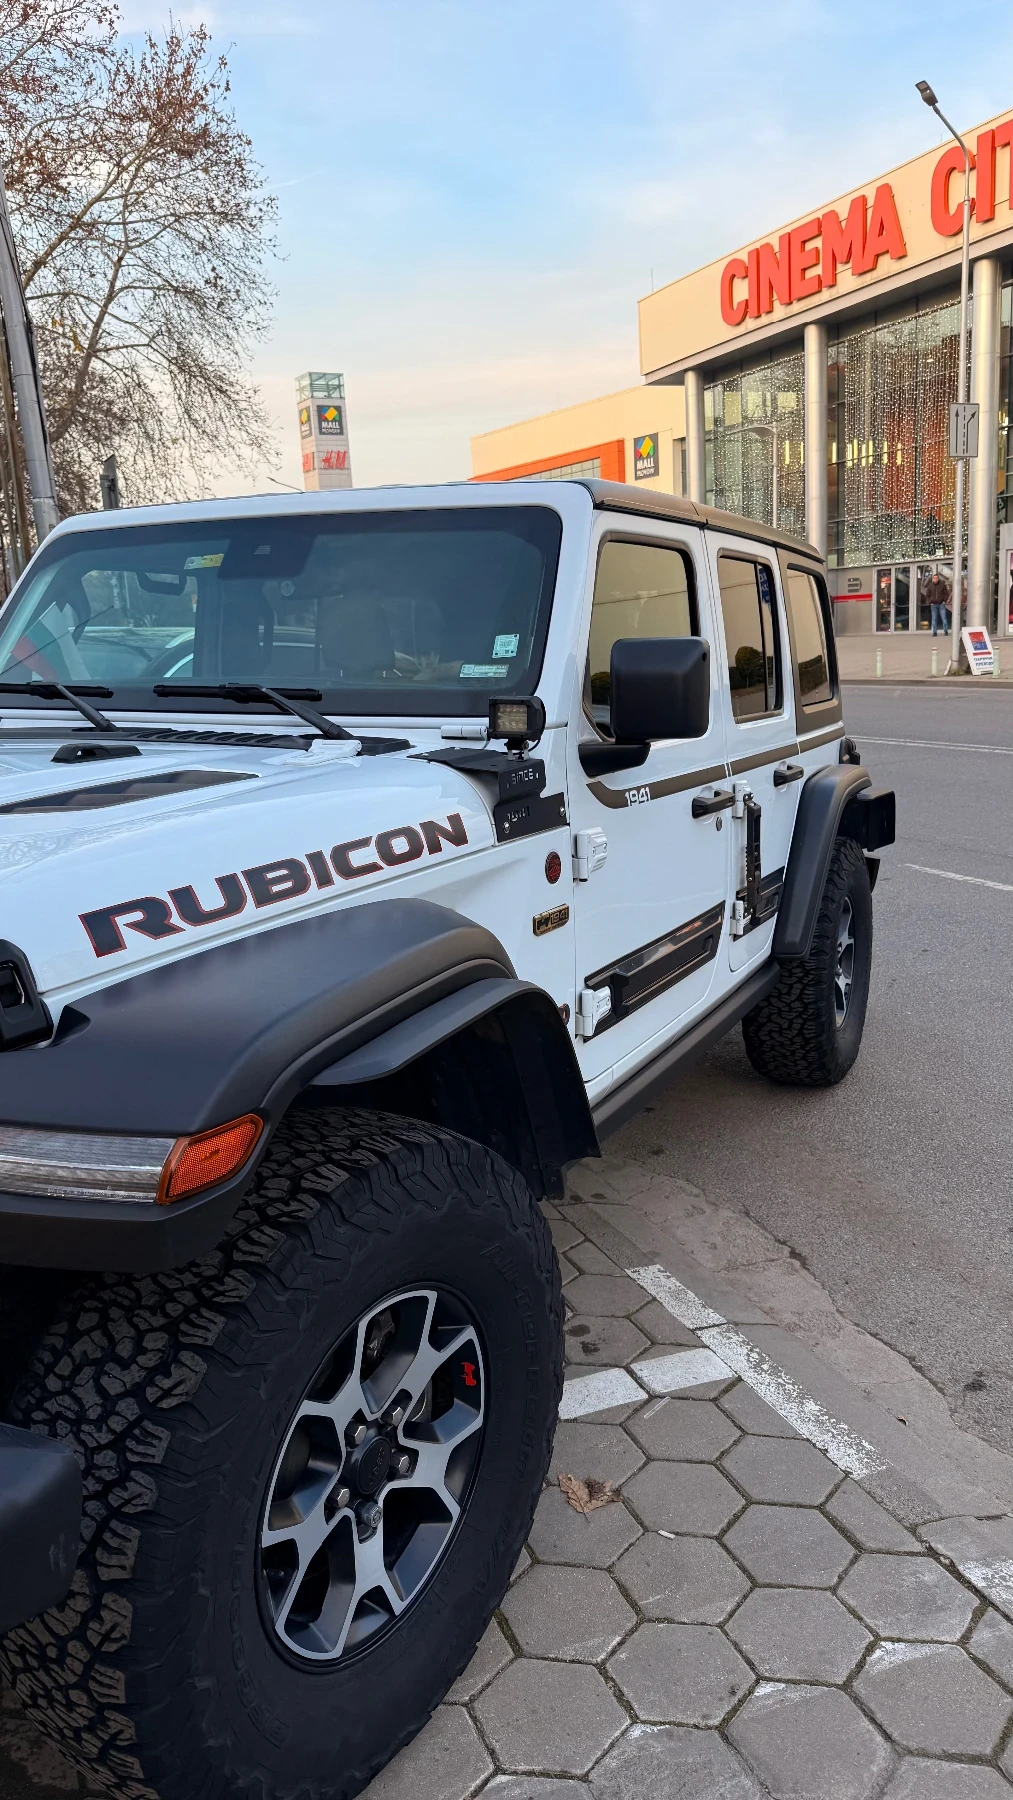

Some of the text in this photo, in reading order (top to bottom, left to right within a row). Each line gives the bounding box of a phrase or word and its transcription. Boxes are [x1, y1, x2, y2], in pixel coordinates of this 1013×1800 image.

[720, 183, 907, 327] CINEMA
[636, 457, 655, 470] MALL
[624, 786, 650, 807] 1941
[78, 812, 469, 958] RUBICON
[549, 908, 569, 924] 1941
